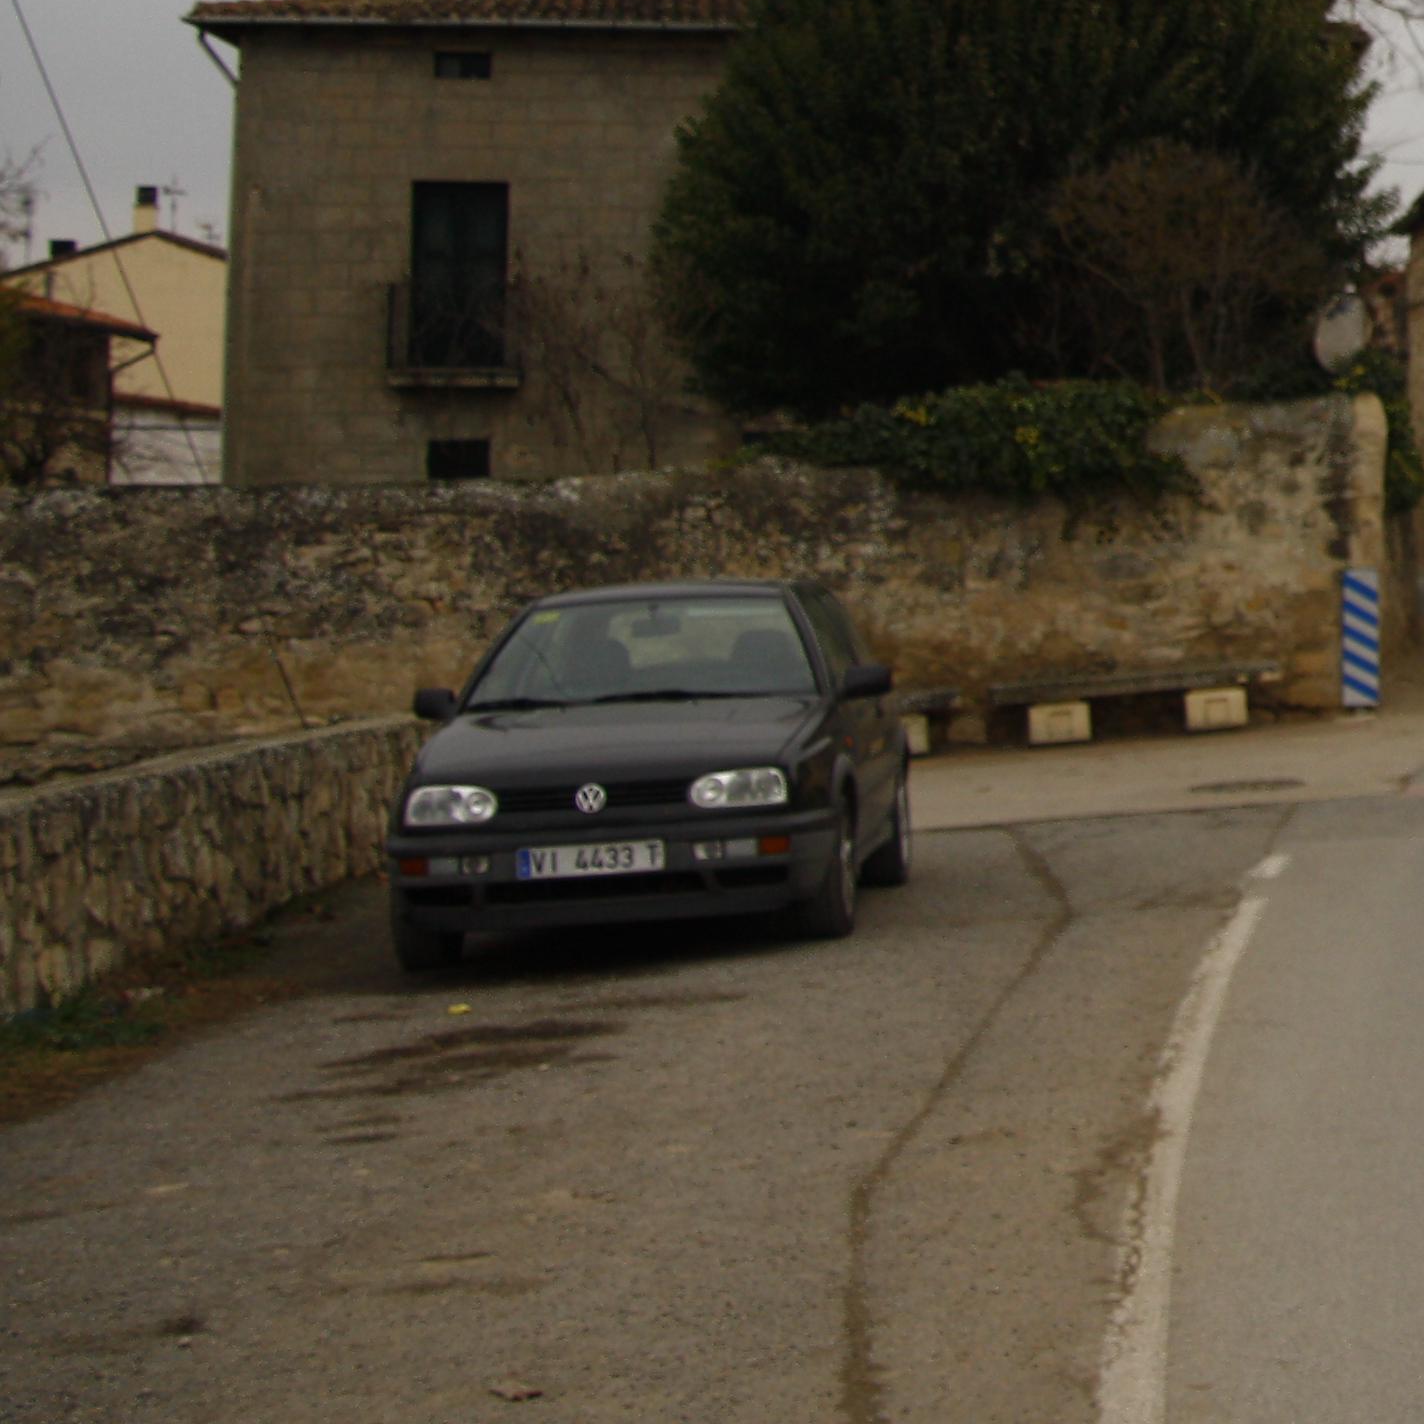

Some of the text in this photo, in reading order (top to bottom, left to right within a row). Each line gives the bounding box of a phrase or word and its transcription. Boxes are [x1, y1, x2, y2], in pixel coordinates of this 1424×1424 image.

[532, 843, 660, 873] VI 4433 T
